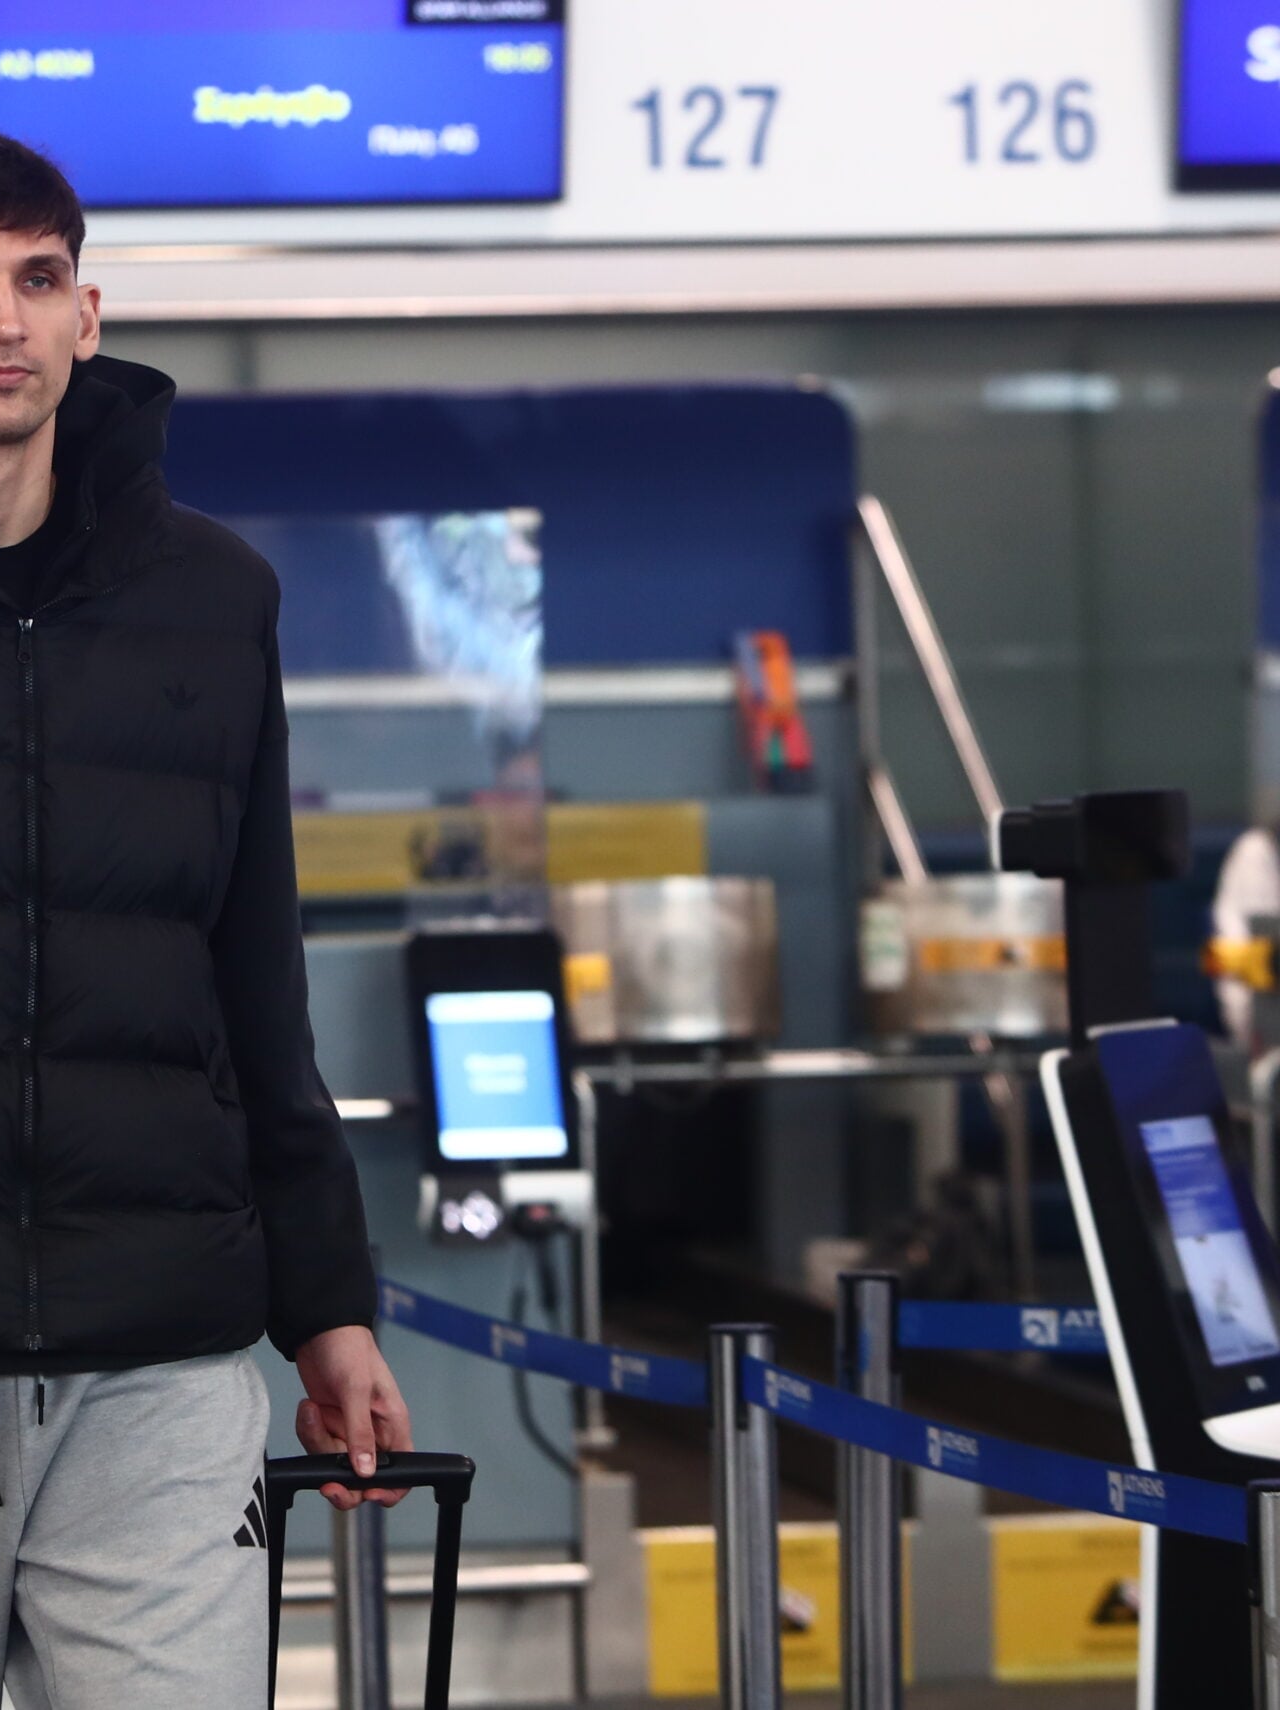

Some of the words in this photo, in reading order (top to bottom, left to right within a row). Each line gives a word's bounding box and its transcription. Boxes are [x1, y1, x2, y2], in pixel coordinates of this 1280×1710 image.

[631, 86, 780, 168] 127
[946, 79, 1096, 164] 126
[1063, 1310, 1100, 1328] AT
[940, 1430, 979, 1457] ATHENS
[1123, 1473, 1166, 1499] ATHENS
